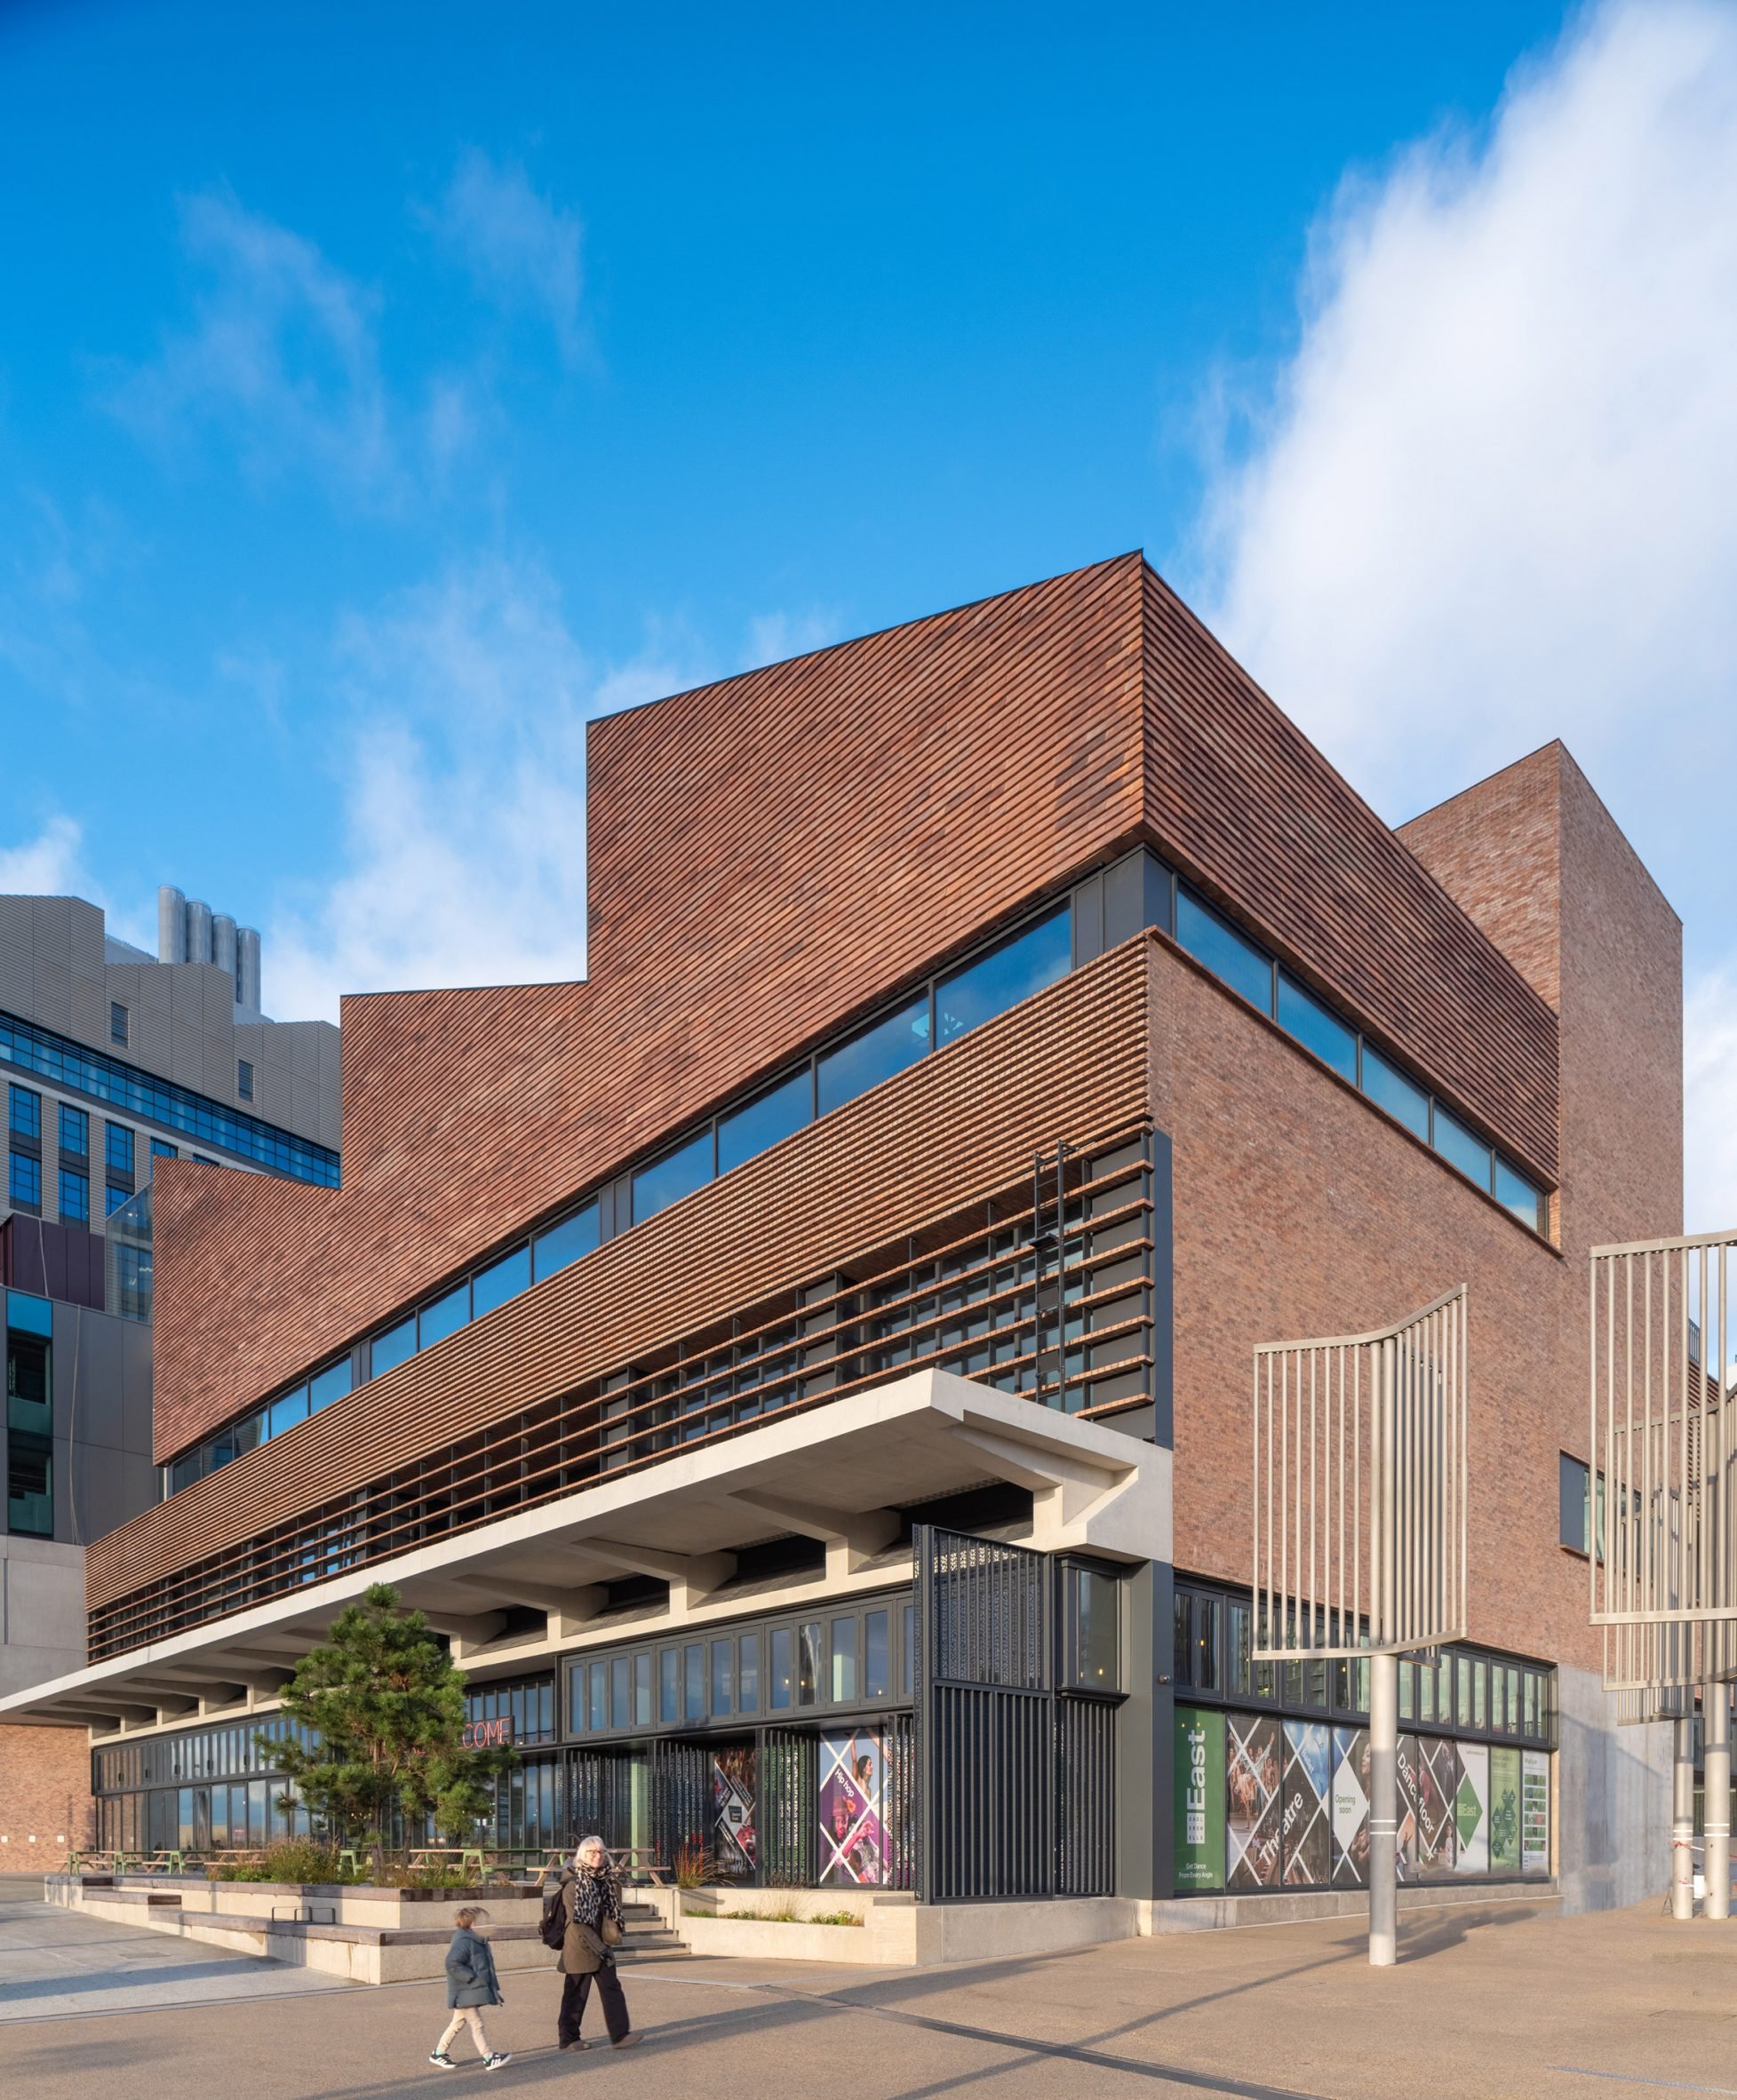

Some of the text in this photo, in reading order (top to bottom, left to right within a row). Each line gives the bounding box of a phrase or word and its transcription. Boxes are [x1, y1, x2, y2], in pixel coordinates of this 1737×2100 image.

[456, 1718, 510, 1749] COME
[1187, 1730, 1206, 1810] East
[1301, 1748, 1315, 1774] Ballet
[834, 1769, 855, 1798] Hip hop
[1335, 1794, 1356, 1805] Opening
[1190, 1871, 1201, 1880] Every
[1201, 1871, 1214, 1880] Angle
